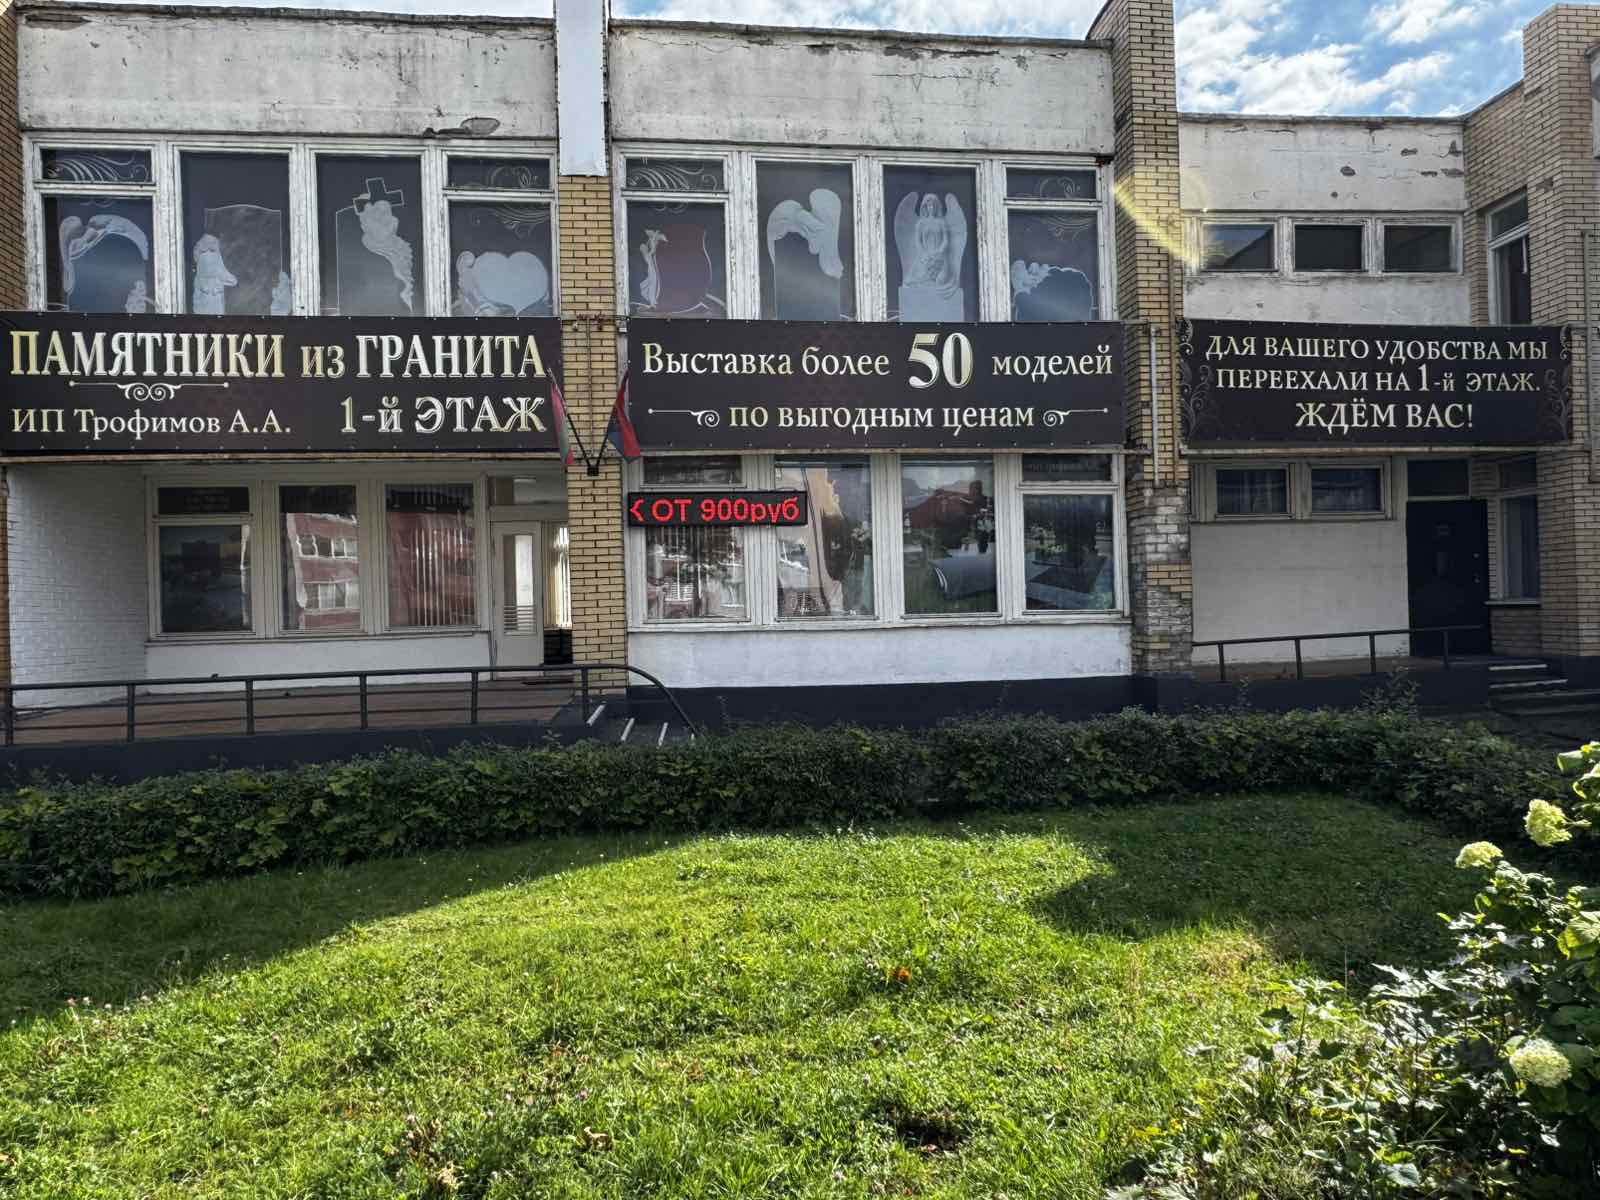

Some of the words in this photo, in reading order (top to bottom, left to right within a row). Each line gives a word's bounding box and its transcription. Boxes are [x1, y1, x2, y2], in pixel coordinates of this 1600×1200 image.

[9, 330, 285, 377] ПАМЯТНИКИ
[300, 345, 345, 378] из
[355, 334, 546, 378] ГРАНИТА
[642, 342, 794, 375] Выставка
[801, 346, 891, 376] более
[908, 332, 974, 389] 50
[992, 344, 1113, 383] моделей
[1205, 335, 1257, 361] ДЛЯ
[1263, 337, 1369, 359] ВАШЕГО
[1375, 340, 1501, 365] УДОБСТВА
[1507, 341, 1548, 360] МЫ
[1215, 368, 1368, 391] ПЕРЕЕХАЛИ
[1375, 371, 1410, 391] НА
[1418, 363, 1455, 392] 1-й
[1465, 372, 1541, 392] ЭТАЖ.
[11, 408, 65, 433] ИП
[73, 408, 221, 440] Трофимов
[228, 409, 292, 433] А.А.
[340, 396, 403, 433] 1-й
[414, 396, 547, 434] ЭТАЖ
[729, 406, 769, 428] по
[778, 406, 933, 435] выгодным
[942, 406, 1035, 437] ценам
[1295, 398, 1397, 435] ЖДЁМ
[1405, 403, 1474, 429] ВАС!
[651, 498, 692, 523] ОТ
[700, 496, 801, 523] 900руб
